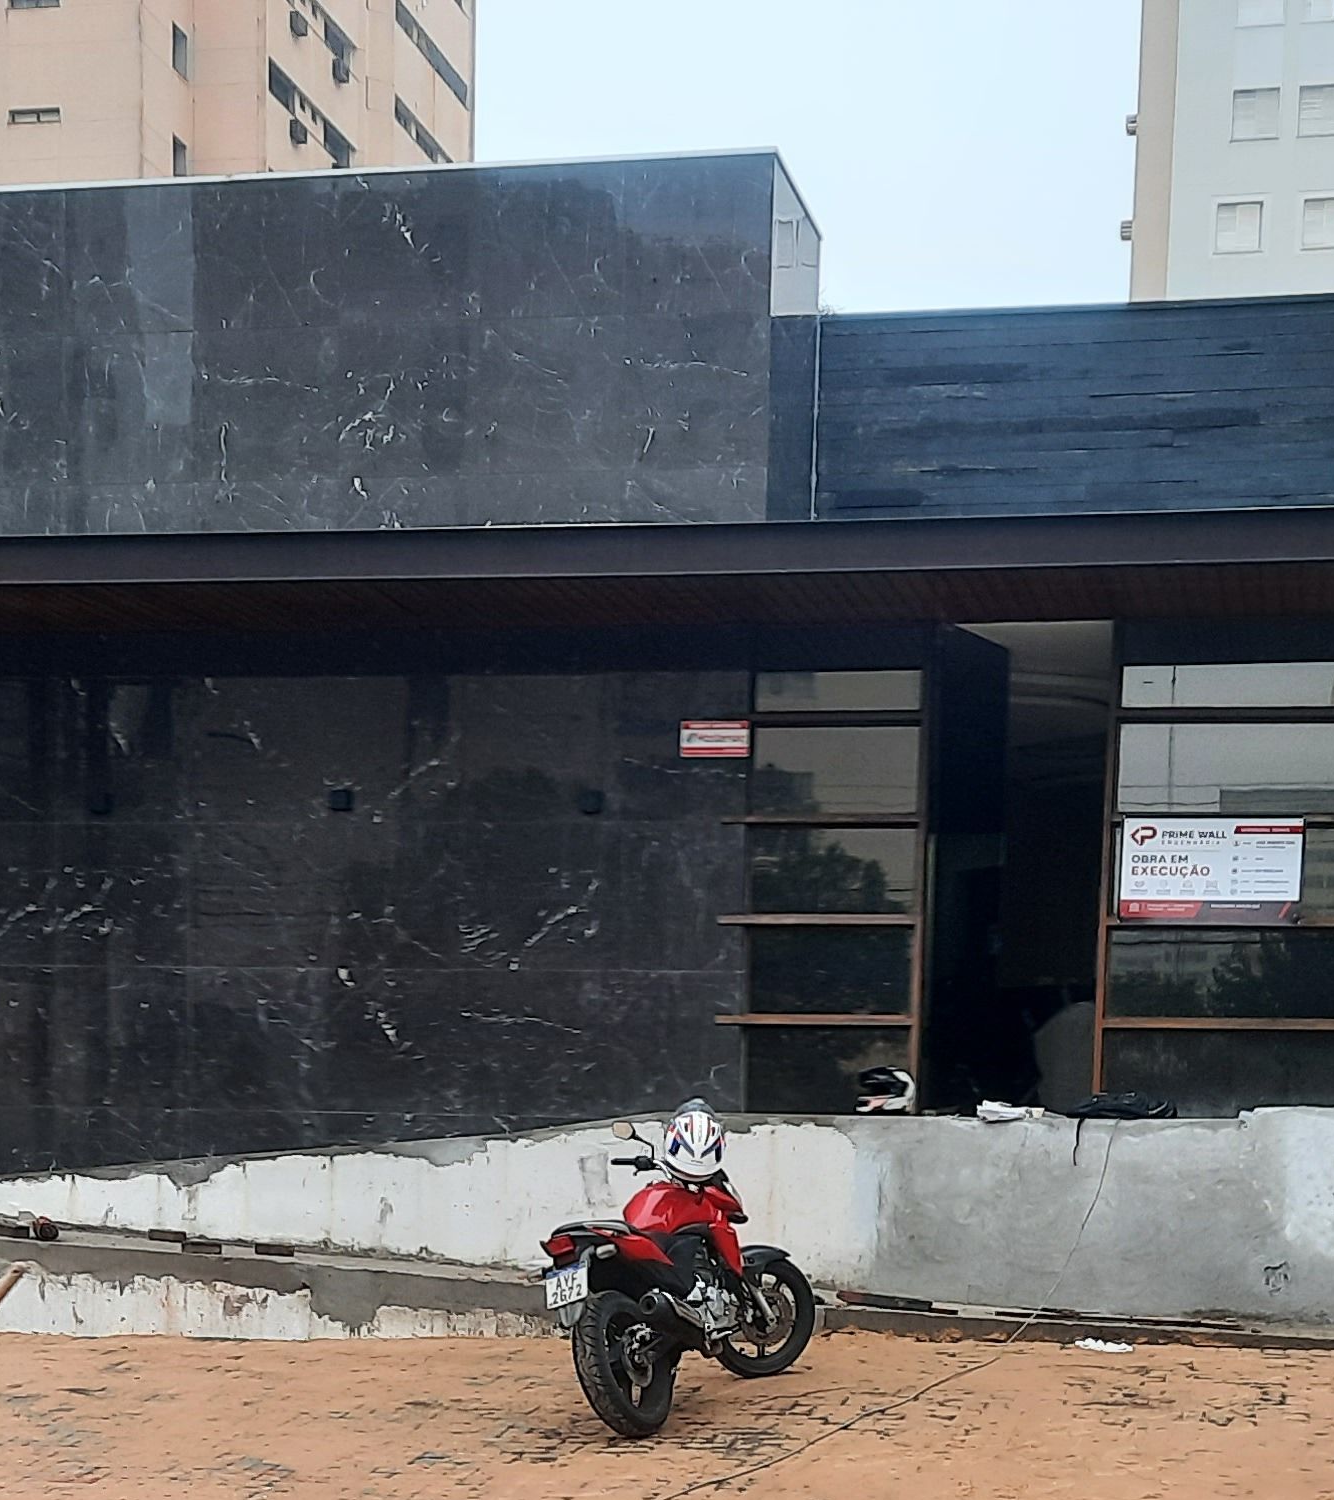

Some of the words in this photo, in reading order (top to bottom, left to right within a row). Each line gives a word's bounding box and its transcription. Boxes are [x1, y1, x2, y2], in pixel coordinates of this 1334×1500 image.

[1198, 830, 1228, 839] WALL
[1131, 854, 1167, 864] OBRA
[1170, 854, 1189, 864] EM
[1131, 864, 1211, 878] EXECUÇÃO
